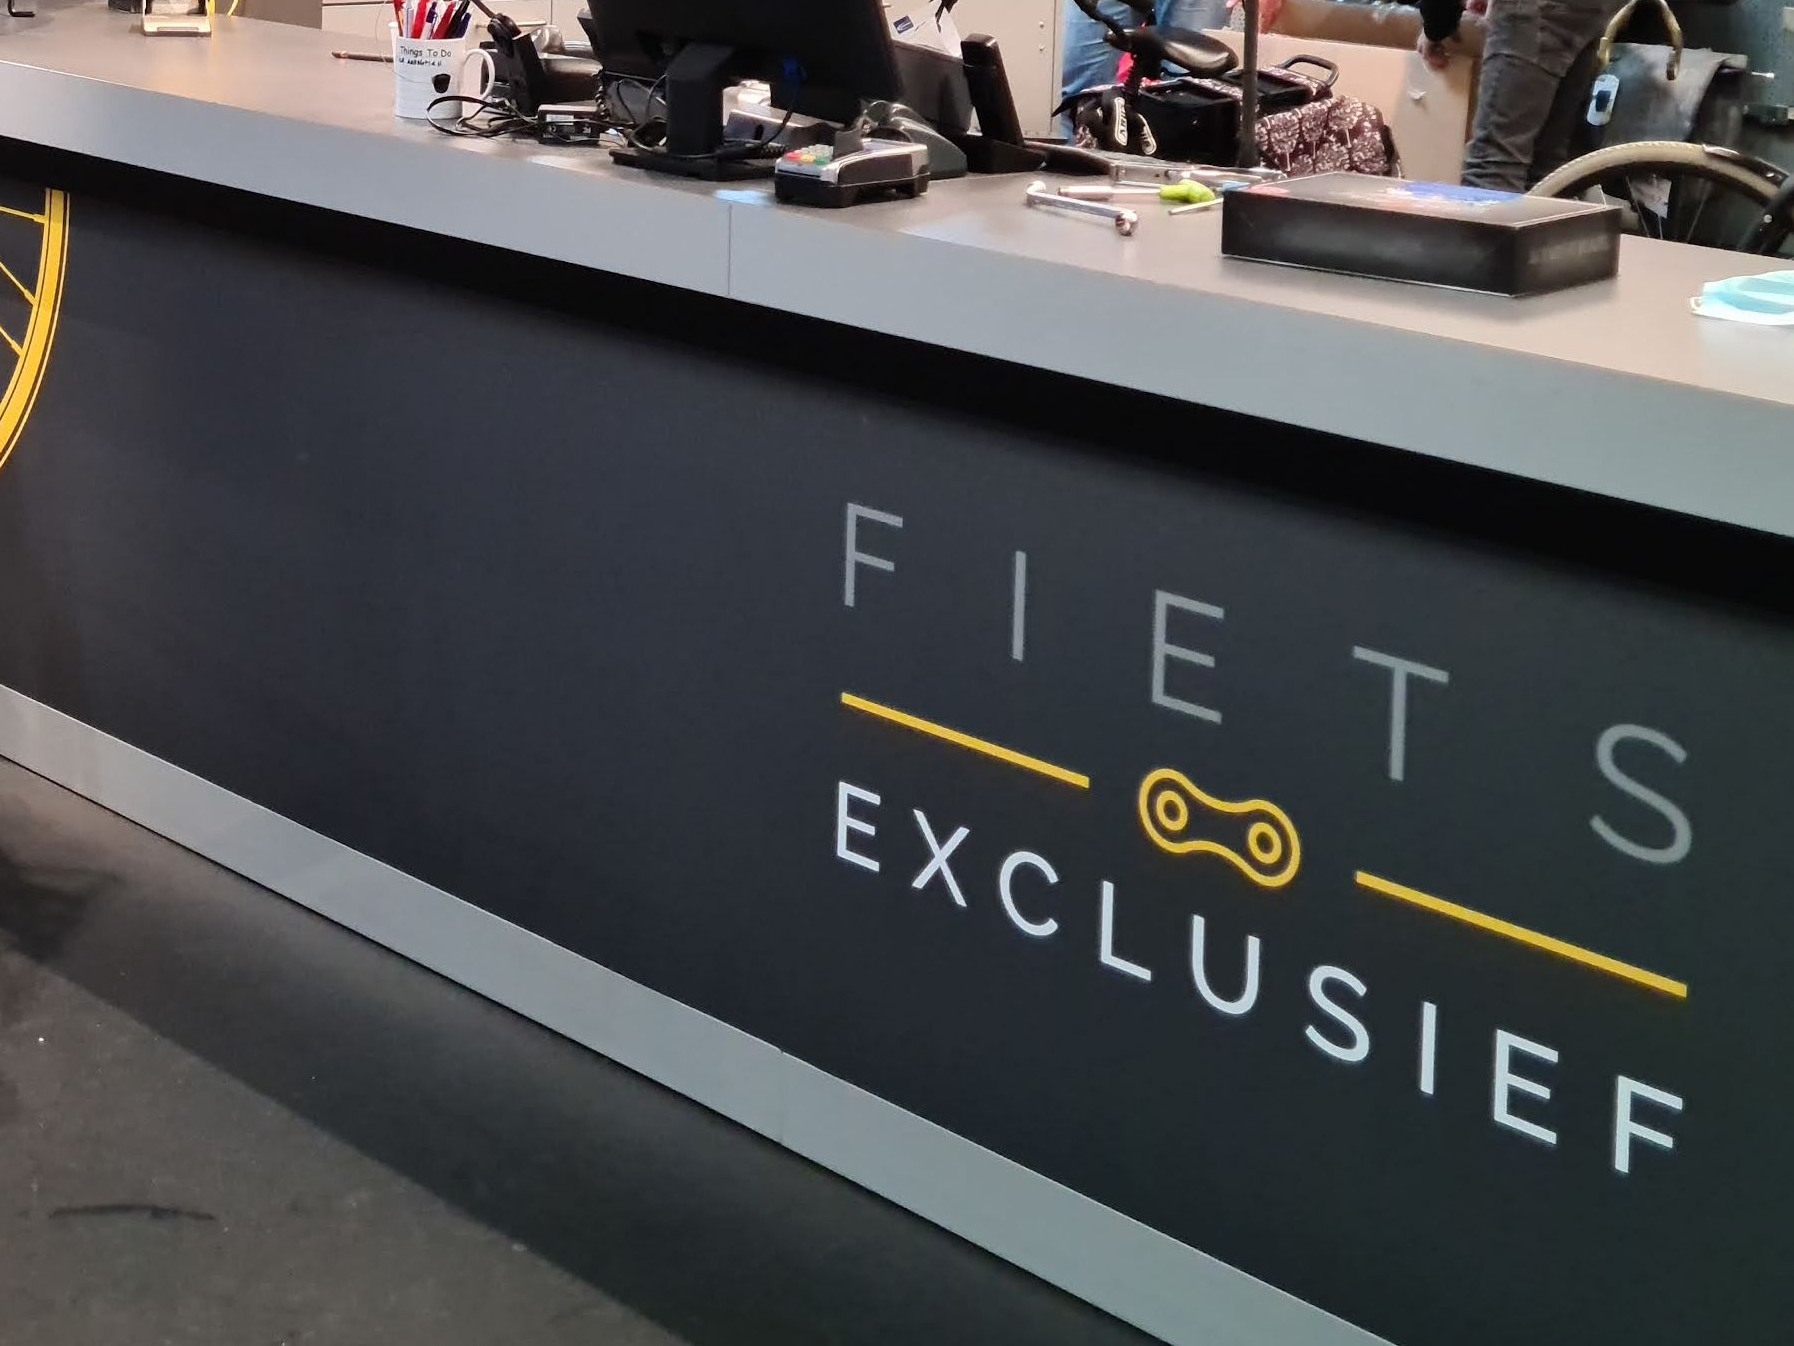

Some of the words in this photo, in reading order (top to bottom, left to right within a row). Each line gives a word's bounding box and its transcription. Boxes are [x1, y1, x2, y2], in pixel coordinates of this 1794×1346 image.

[400, 45, 423, 58] Things
[427, 48, 439, 58] To
[440, 48, 452, 58] Do
[843, 501, 1692, 865] FIETS
[836, 780, 1684, 1174] EXCLUSIEF
